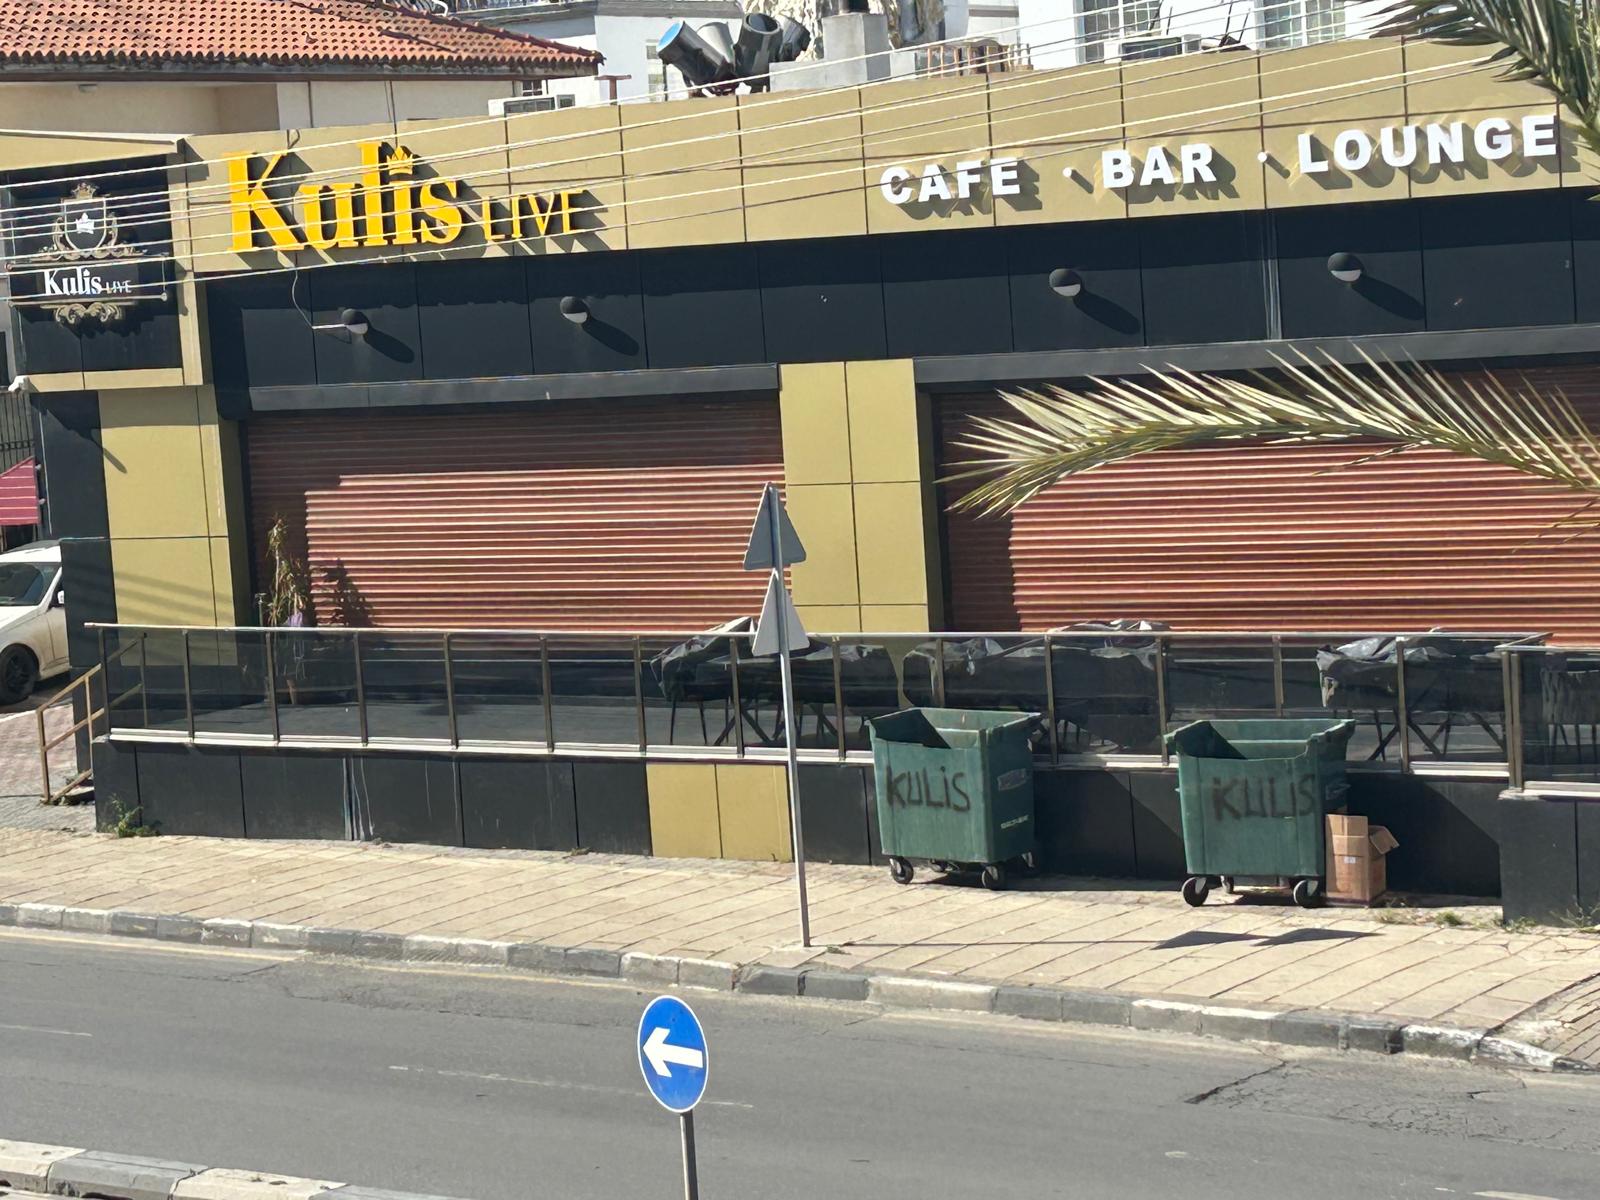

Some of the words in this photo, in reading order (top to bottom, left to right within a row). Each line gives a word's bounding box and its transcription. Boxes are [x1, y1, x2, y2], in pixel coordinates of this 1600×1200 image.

[222, 141, 463, 252] Kulis
[482, 189, 586, 240] LIVE
[880, 157, 1021, 205] CAFE
[1102, 143, 1217, 189] BAR
[1297, 114, 1559, 174] LOUNGE
[43, 266, 102, 295] Kulis
